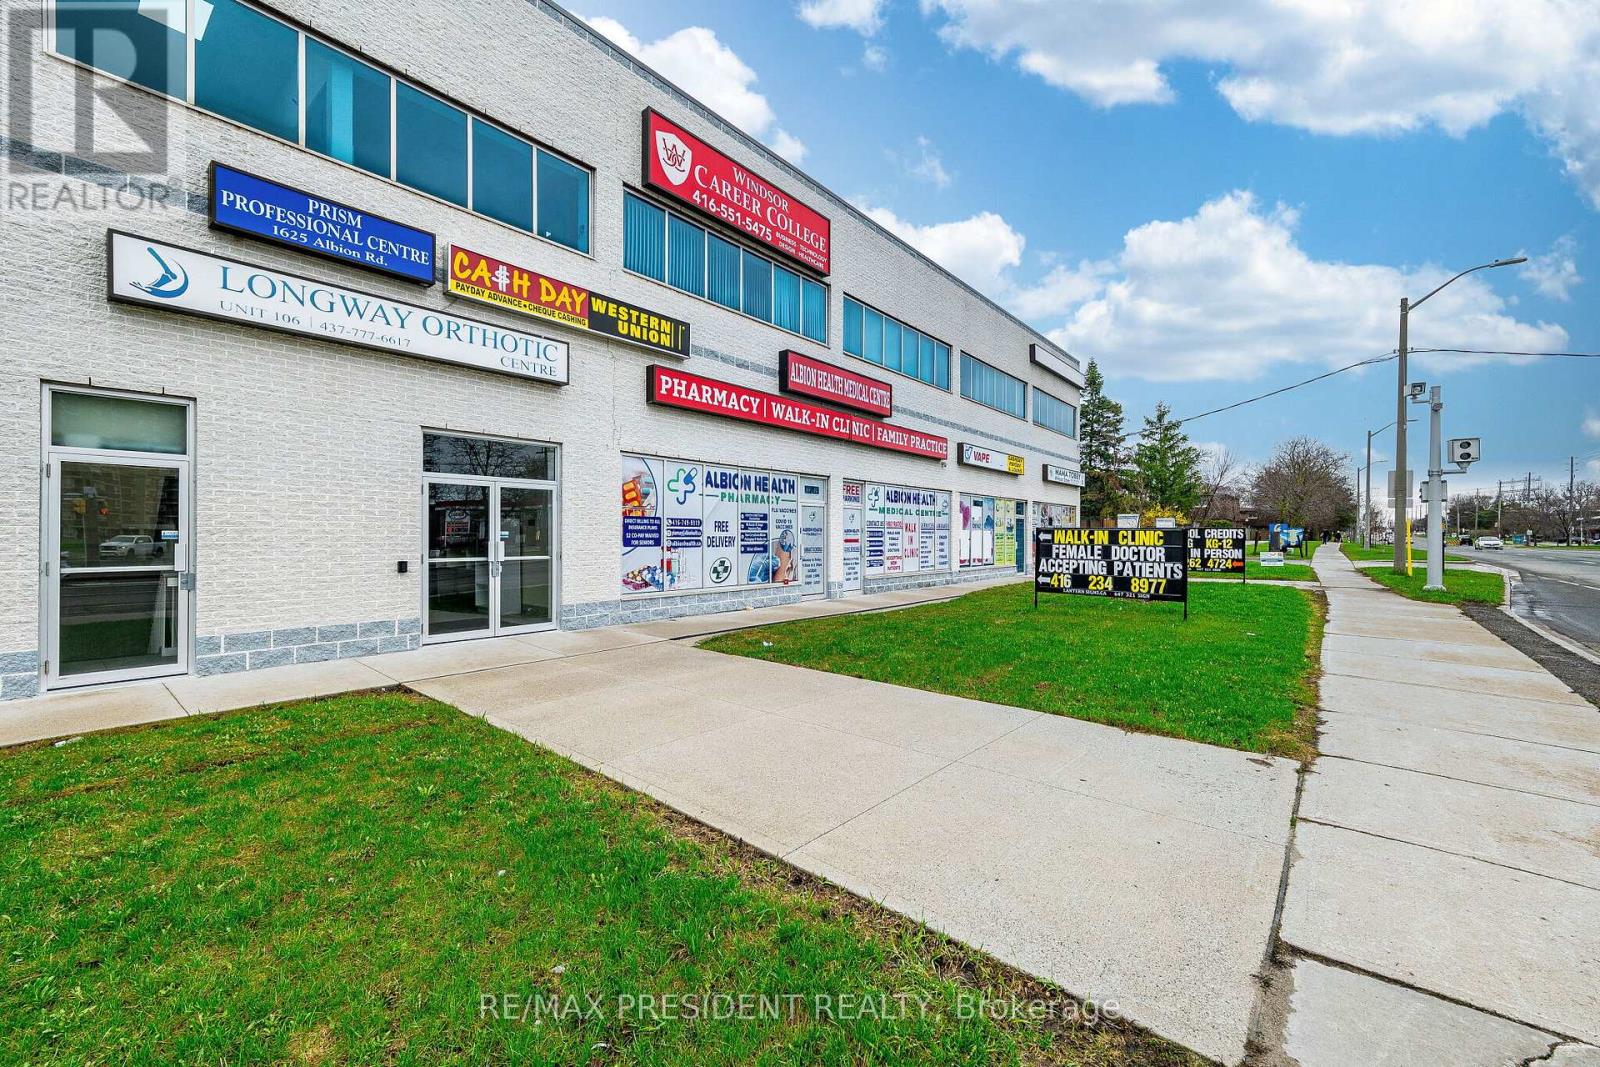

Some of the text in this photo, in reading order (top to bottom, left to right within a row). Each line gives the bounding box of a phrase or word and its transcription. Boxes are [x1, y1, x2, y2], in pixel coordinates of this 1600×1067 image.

[732, 166, 789, 212] WINDSOR
[308, 198, 362, 229] PRISM
[692, 189, 772, 242] 416-551-5475
[694, 164, 827, 253] CAREER COLLEGE
[221, 189, 430, 265] PROFESSIONAL CENTRE
[273, 225, 388, 267] 1625 Albion Rd.
[453, 251, 587, 314] CA$H DAY
[218, 265, 558, 362] LONGWAY ORTHOTIC
[456, 281, 587, 326] PAYDAY ADVANCE CHEQUE CASHING
[220, 300, 411, 347] UNIT 106 437-777-6617
[590, 297, 672, 333] WESTERN
[617, 320, 672, 347] UNION
[500, 355, 558, 377] CENTRE
[791, 362, 891, 408] ALBION HEALTH MEDICAL CENTRE
[660, 375, 947, 455] PHARMACY WALK-IN CLINIC FAMILY PRACTICE
[973, 450, 990, 464] VAPE
[705, 470, 795, 495] ALBION HEALTH
[843, 484, 860, 496] FREE
[720, 492, 781, 505] PHARMACY
[886, 490, 937, 506] ALBION HEALTH
[879, 507, 942, 517] MEDICAL CENTRE
[714, 520, 729, 533] FREE
[905, 523, 916, 533] WALK
[1204, 529, 1244, 539] CREDITS
[707, 536, 736, 548] DELIVERY
[1054, 530, 1164, 546] WALK-IN CLINIC
[1206, 539, 1232, 549] KG-12
[904, 549, 918, 558] CLINIC
[1052, 545, 1165, 562] FEMALE DOCTOR
[1190, 549, 1242, 559] IN PERSON
[1207, 558, 1232, 568] 4724
[1039, 559, 1183, 580] ACCEPTING PATIENTS
[1050, 573, 1167, 594] 416 234 8977
